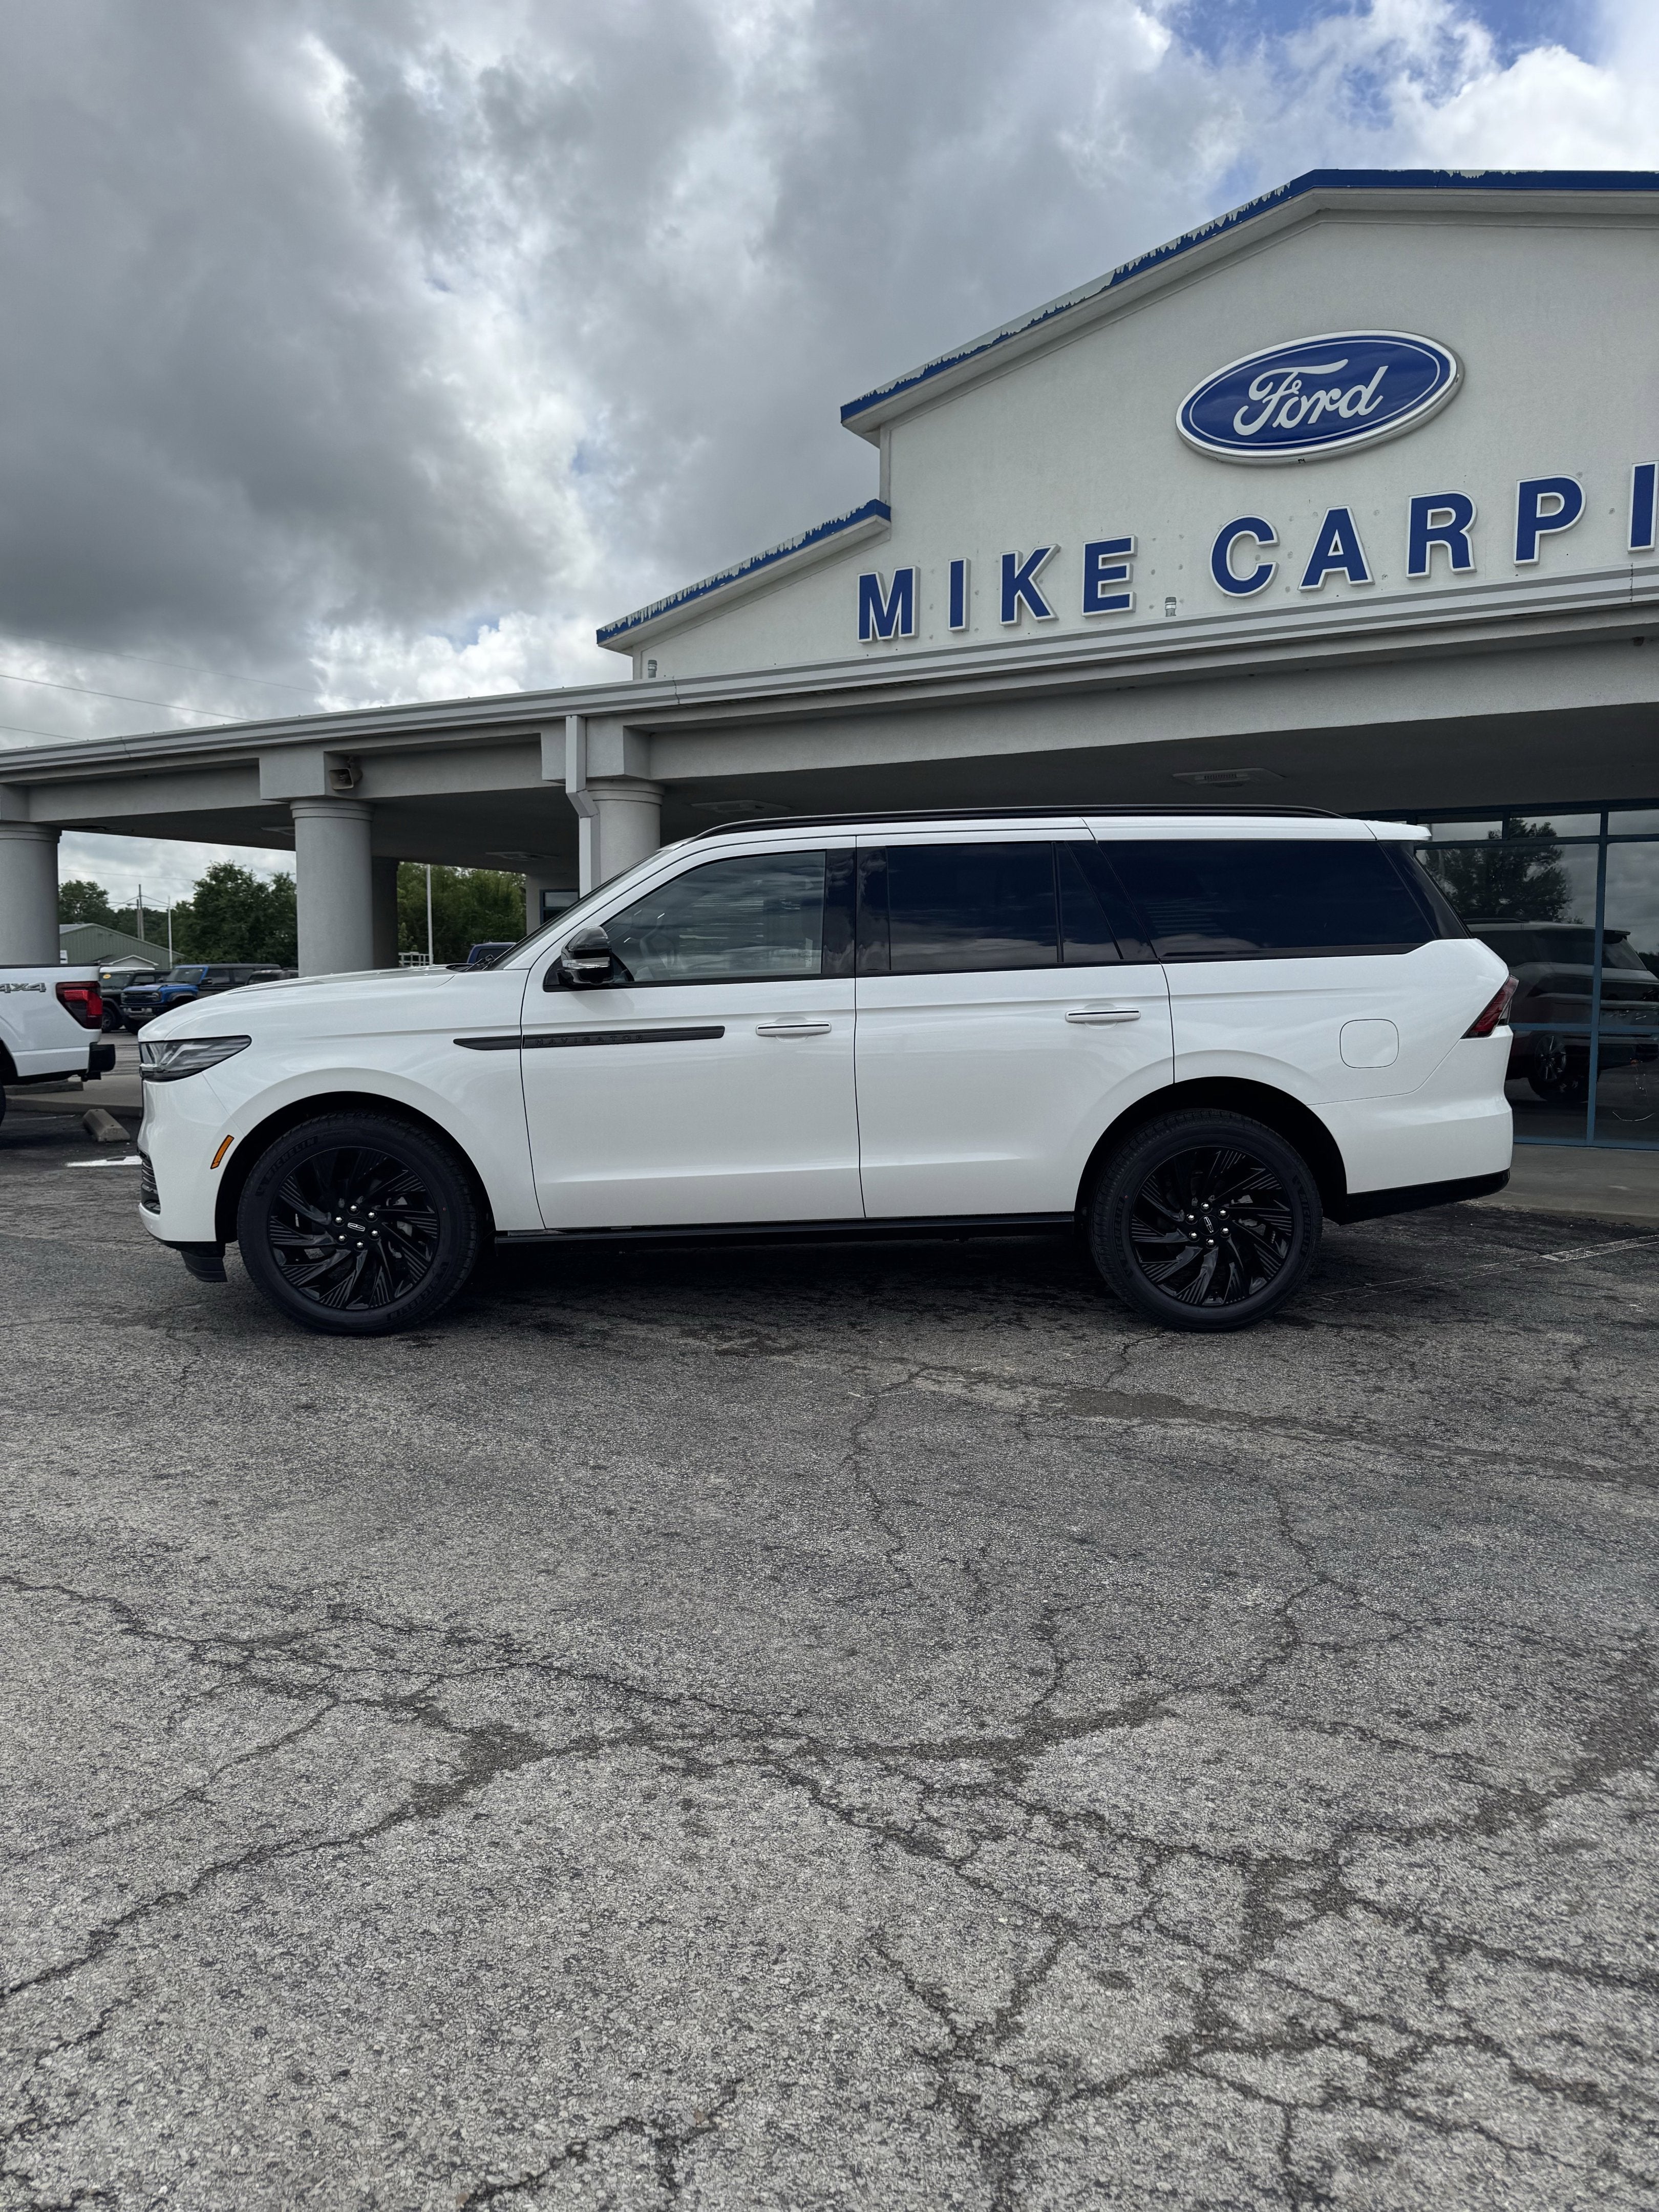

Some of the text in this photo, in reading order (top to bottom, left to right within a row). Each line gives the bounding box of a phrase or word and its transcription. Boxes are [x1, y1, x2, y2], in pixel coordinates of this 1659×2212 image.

[1233, 358, 1389, 436] Ford
[857, 459, 1659, 644] MIKE CARPI
[536, 1034, 643, 1046] NAVIGATOR
[264, 1136, 316, 1181] MICHELIN
[1298, 1192, 1311, 1253] MICHELIN
